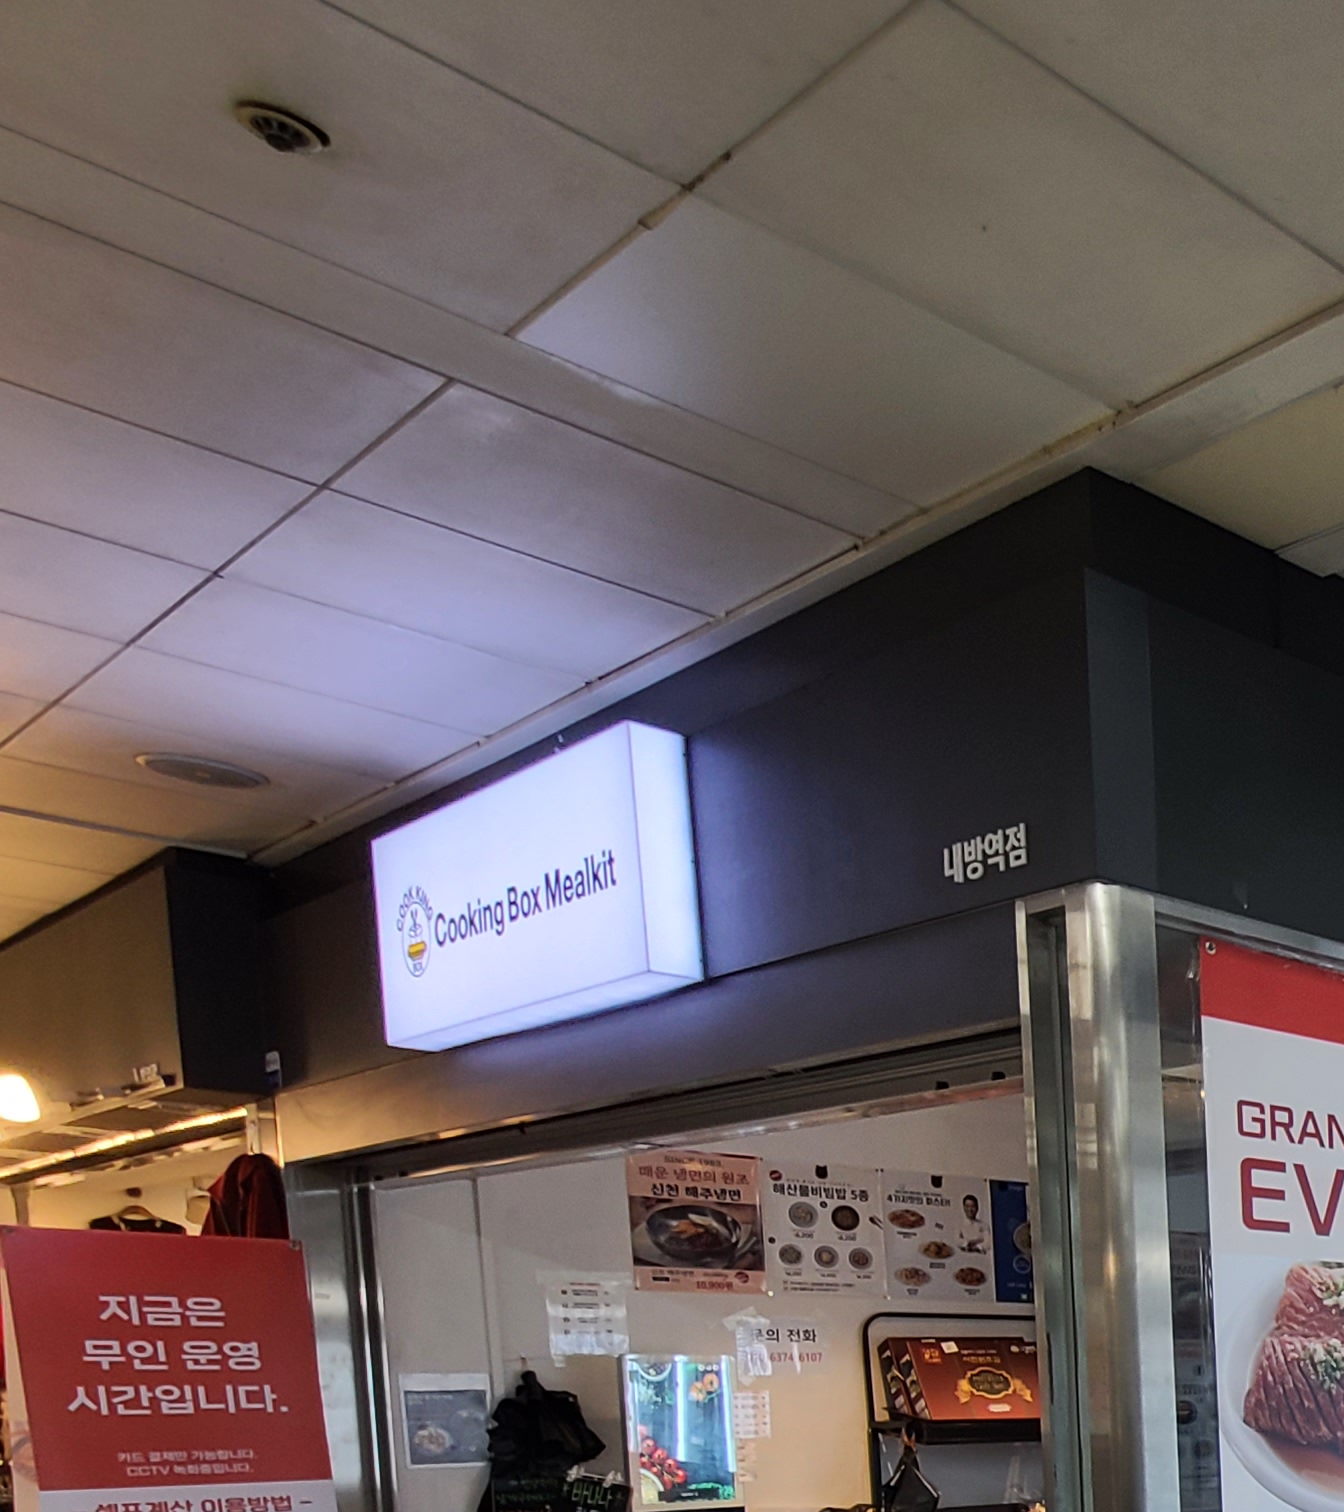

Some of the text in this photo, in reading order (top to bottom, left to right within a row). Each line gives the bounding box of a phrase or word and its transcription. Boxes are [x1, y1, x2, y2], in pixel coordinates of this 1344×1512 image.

[943, 823, 1028, 884] 내방역점
[434, 848, 617, 947] Cooking Box Mealkit
[639, 1166, 750, 1185] 매운 냉면의 원조
[651, 1183, 741, 1200] 신천 해주냉면
[772, 1184, 869, 1202] 해산물비빔밥 5종
[98, 1295, 226, 1328] 지금은
[787, 1328, 817, 1343] 전화
[82, 1339, 262, 1371] 무인 운영
[799, 1352, 823, 1362] 6107
[67, 1384, 289, 1416] 시간입니다.
[126, 1466, 170, 1477] CCTV
